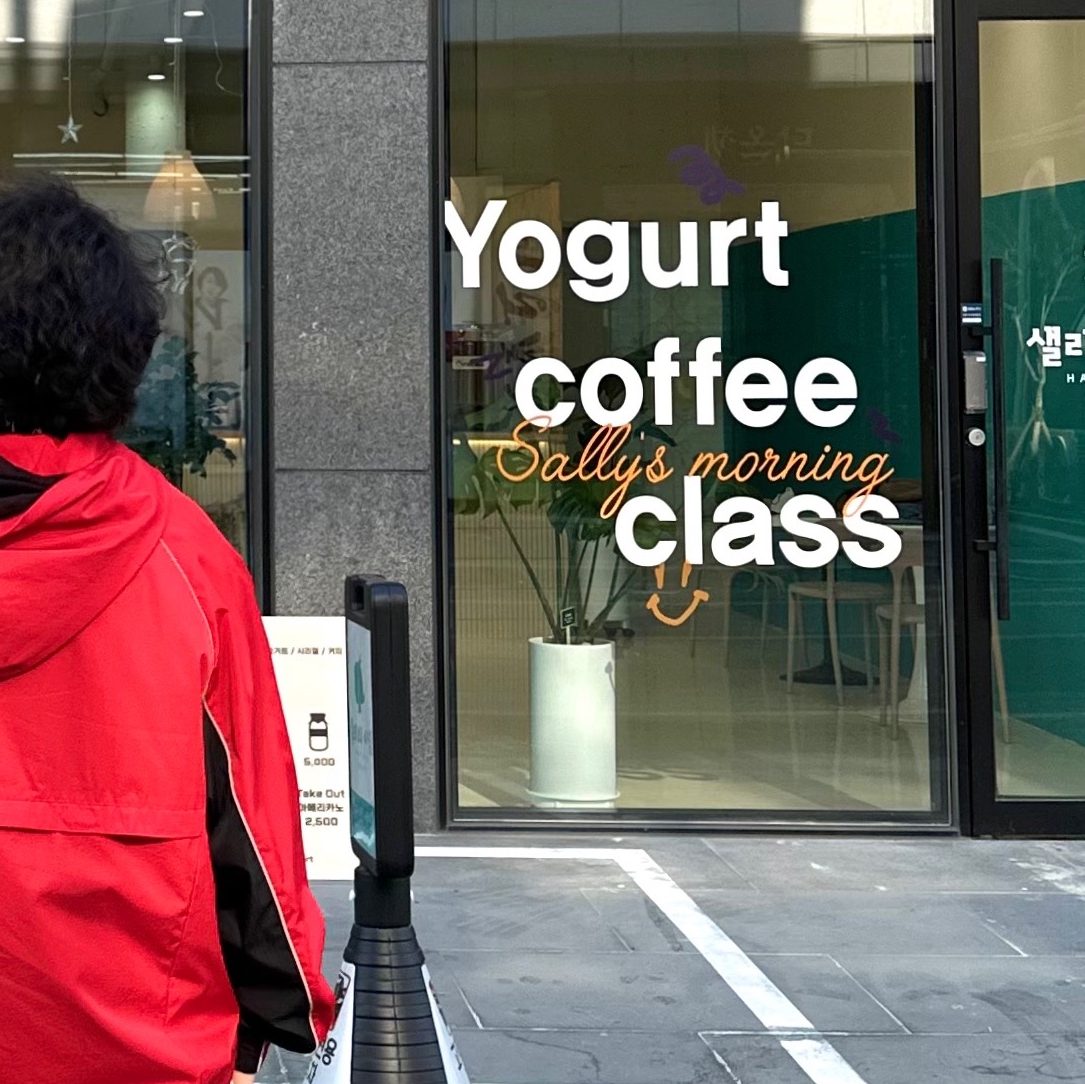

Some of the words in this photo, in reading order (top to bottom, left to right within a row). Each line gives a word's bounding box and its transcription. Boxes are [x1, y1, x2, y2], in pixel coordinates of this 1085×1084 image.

[444, 200, 789, 302] Yogurt
[515, 337, 857, 428] coffee
[497, 415, 674, 519] Sally's
[688, 445, 895, 518] morning
[616, 475, 902, 569] class
[303, 757, 336, 767] 5,000
[325, 789, 345, 798] Out
[305, 817, 339, 827] 2,500
